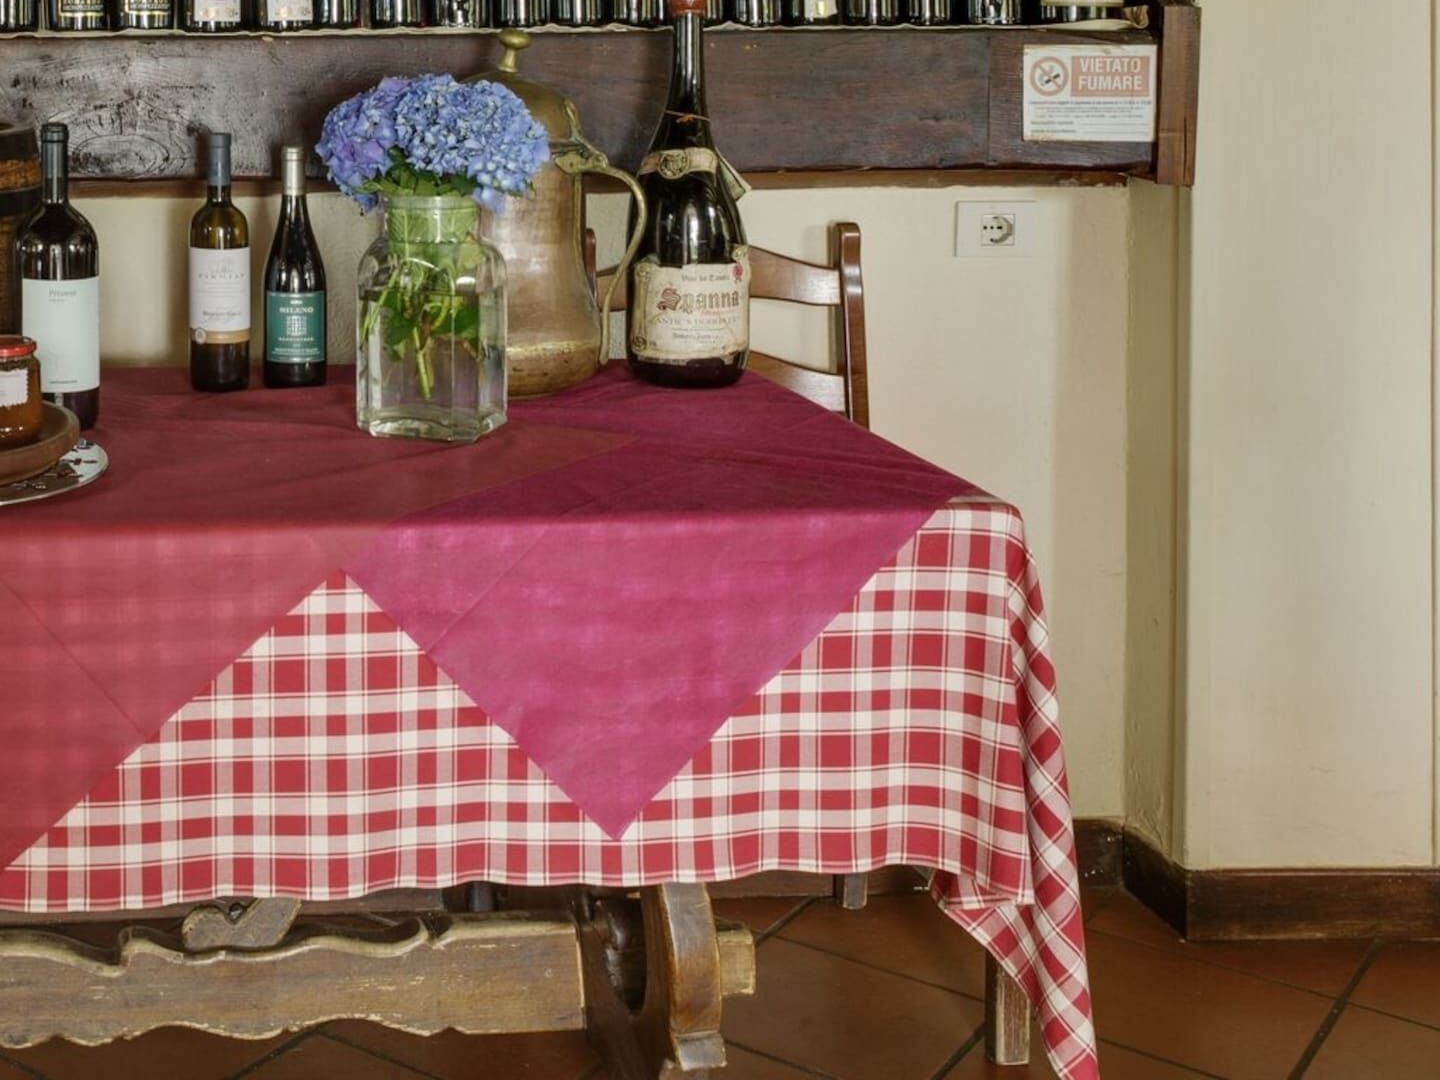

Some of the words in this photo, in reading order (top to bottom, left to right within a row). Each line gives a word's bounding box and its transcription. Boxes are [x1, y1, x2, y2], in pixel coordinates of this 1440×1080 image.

[1080, 57, 1141, 73] VIETATO
[1078, 75, 1142, 90] FUMARE
[657, 287, 740, 314] Spanna
